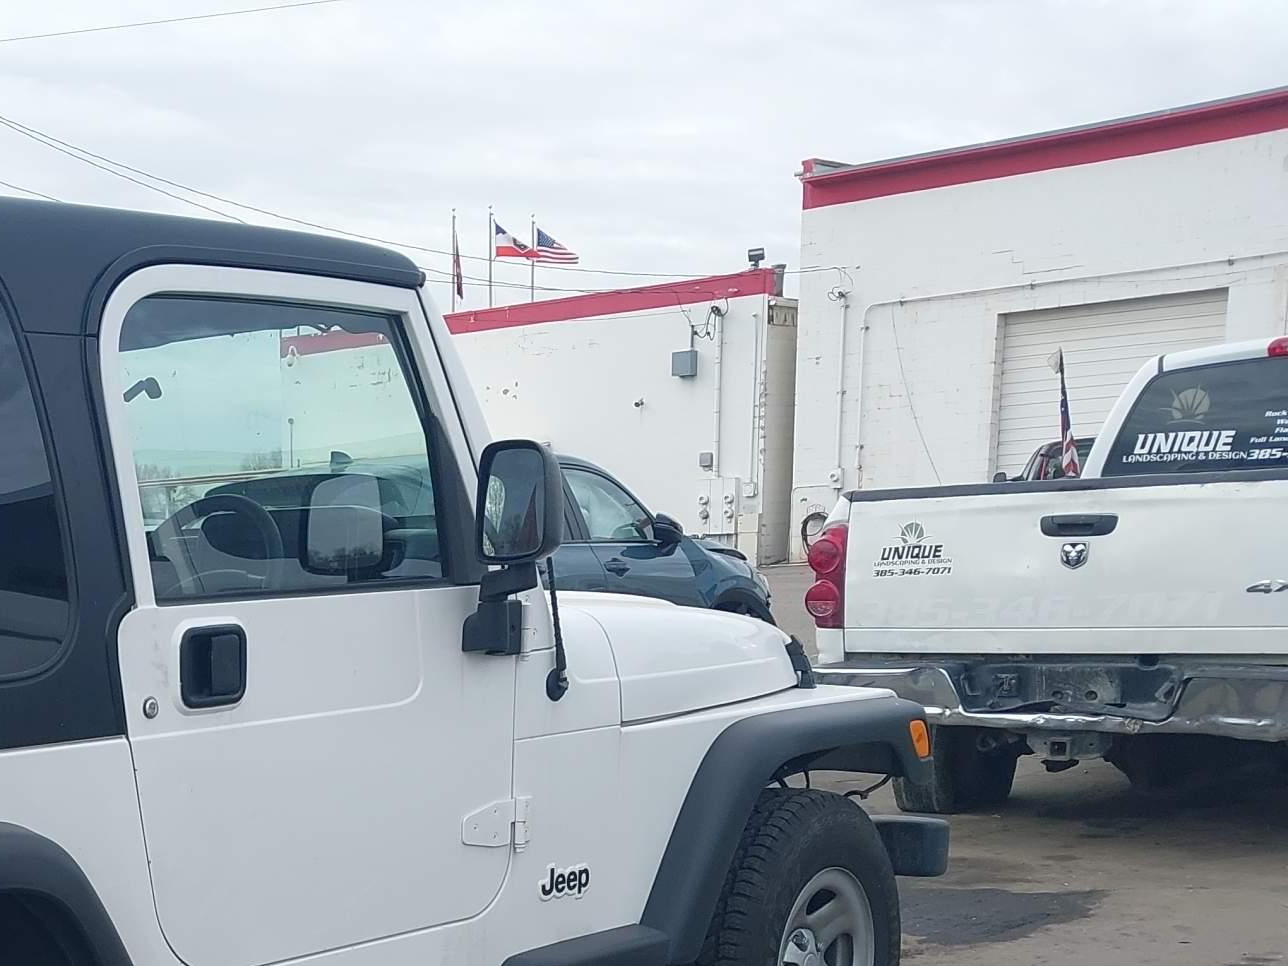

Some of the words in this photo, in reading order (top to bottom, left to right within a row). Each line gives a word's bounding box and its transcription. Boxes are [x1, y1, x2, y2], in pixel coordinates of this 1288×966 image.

[1134, 431, 1236, 454] UNIQUE
[1122, 452, 1197, 463] LANDSCAPING
[1198, 452, 1206, 460] &
[1208, 450, 1248, 461] DESIGN
[880, 544, 943, 561] UNIQUE
[873, 559, 920, 567] LANDSCAPING
[873, 567, 952, 577] 385-346-7071
[541, 867, 590, 897] Jeep
